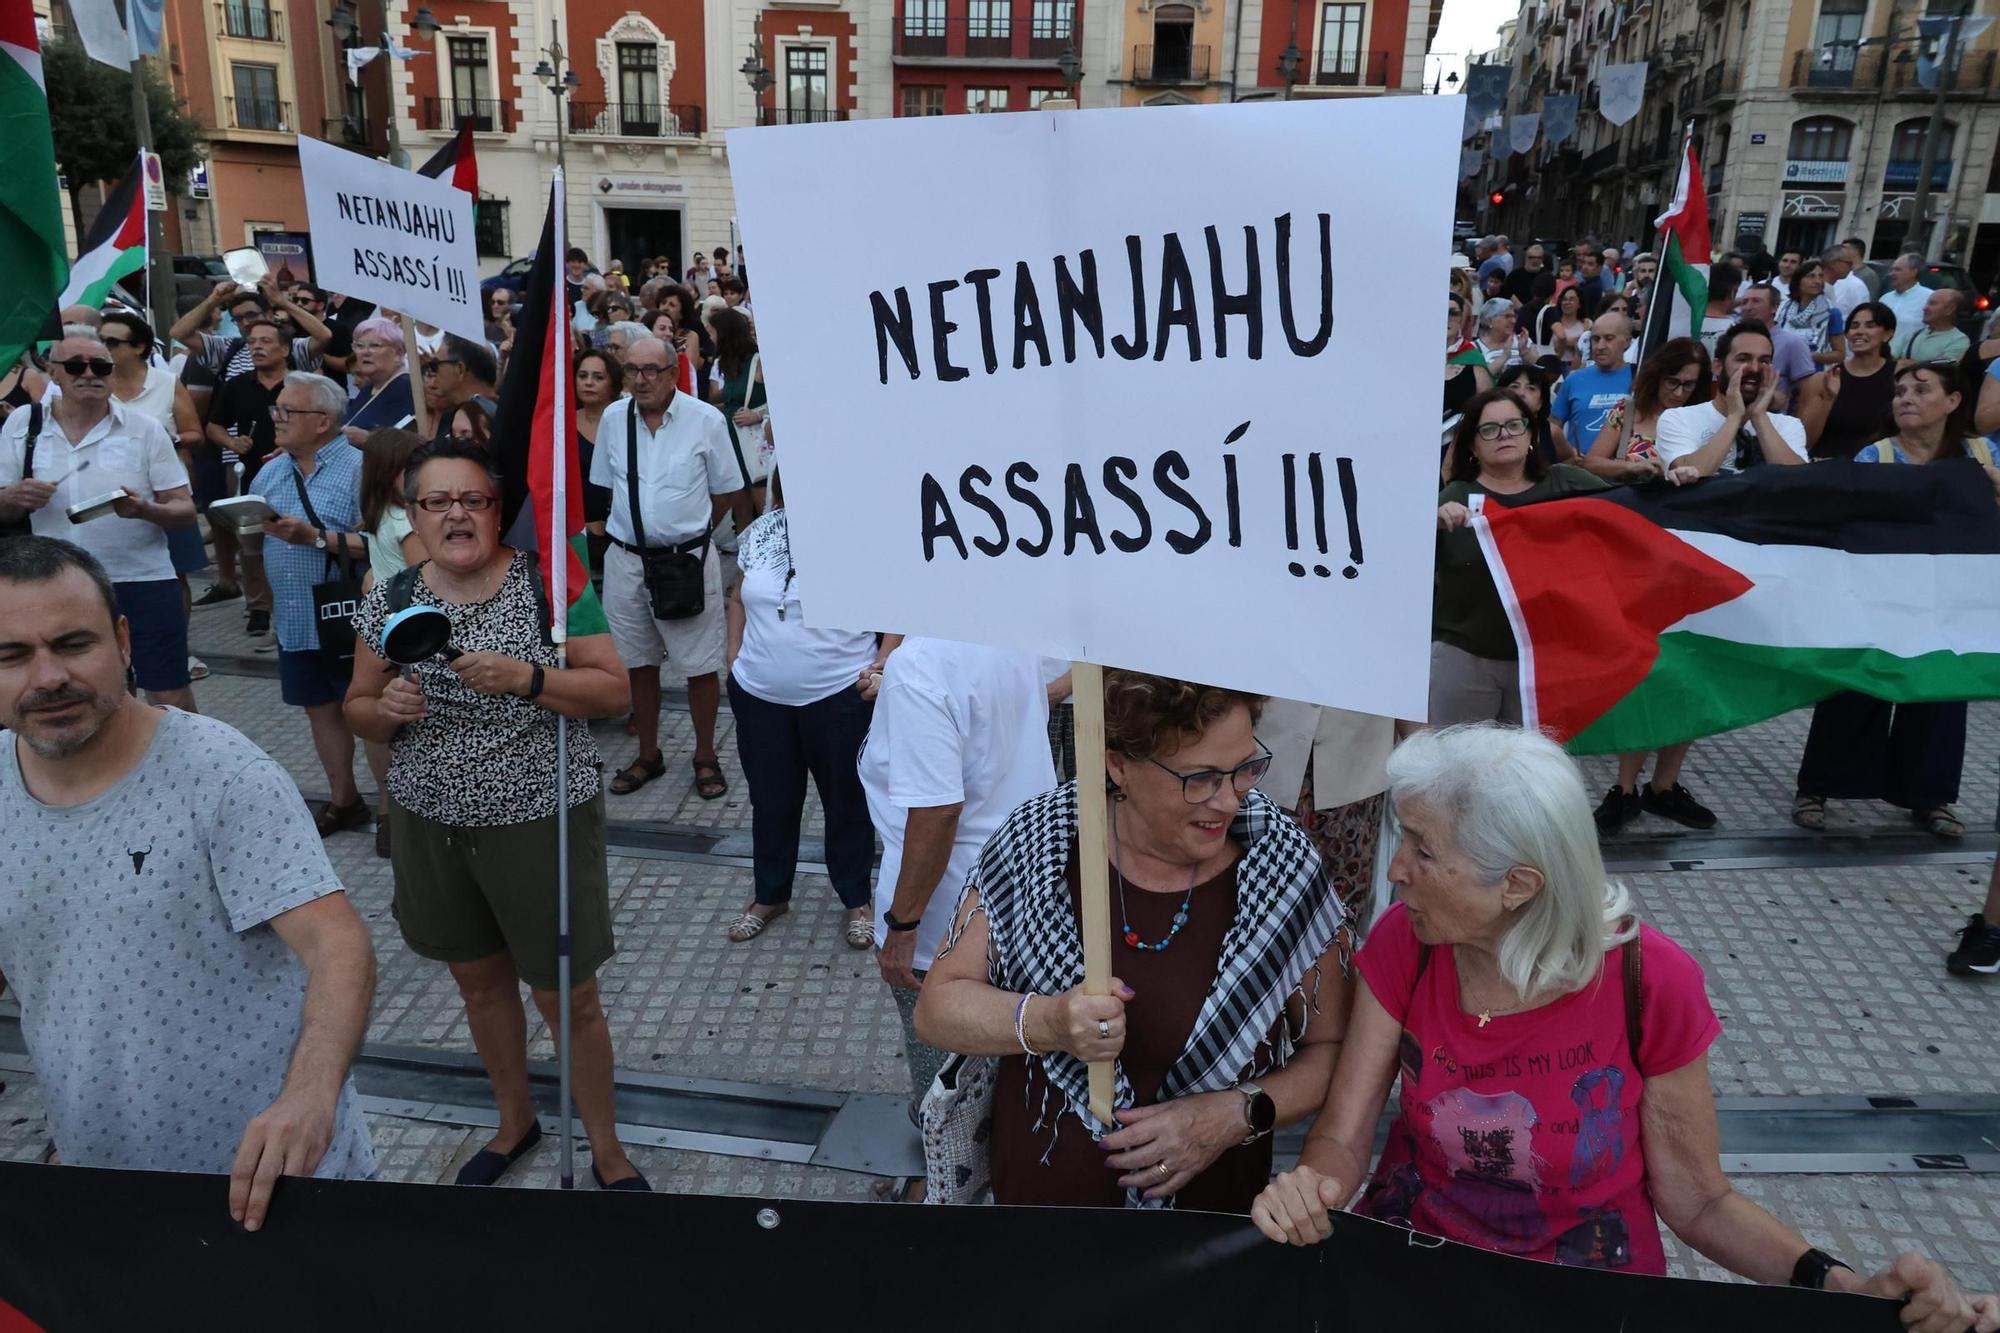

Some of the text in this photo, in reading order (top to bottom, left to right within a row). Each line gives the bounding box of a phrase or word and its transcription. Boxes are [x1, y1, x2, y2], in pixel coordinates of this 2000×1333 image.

[336, 191, 456, 245] NETANJAHU
[353, 247, 468, 305] ASSASSÍ !!!
[868, 212, 1334, 385] NETANJAHU
[920, 420, 1364, 580] ASSASSÍ !!!
[1461, 1041, 1598, 1082] THIS IS MY LOOK
